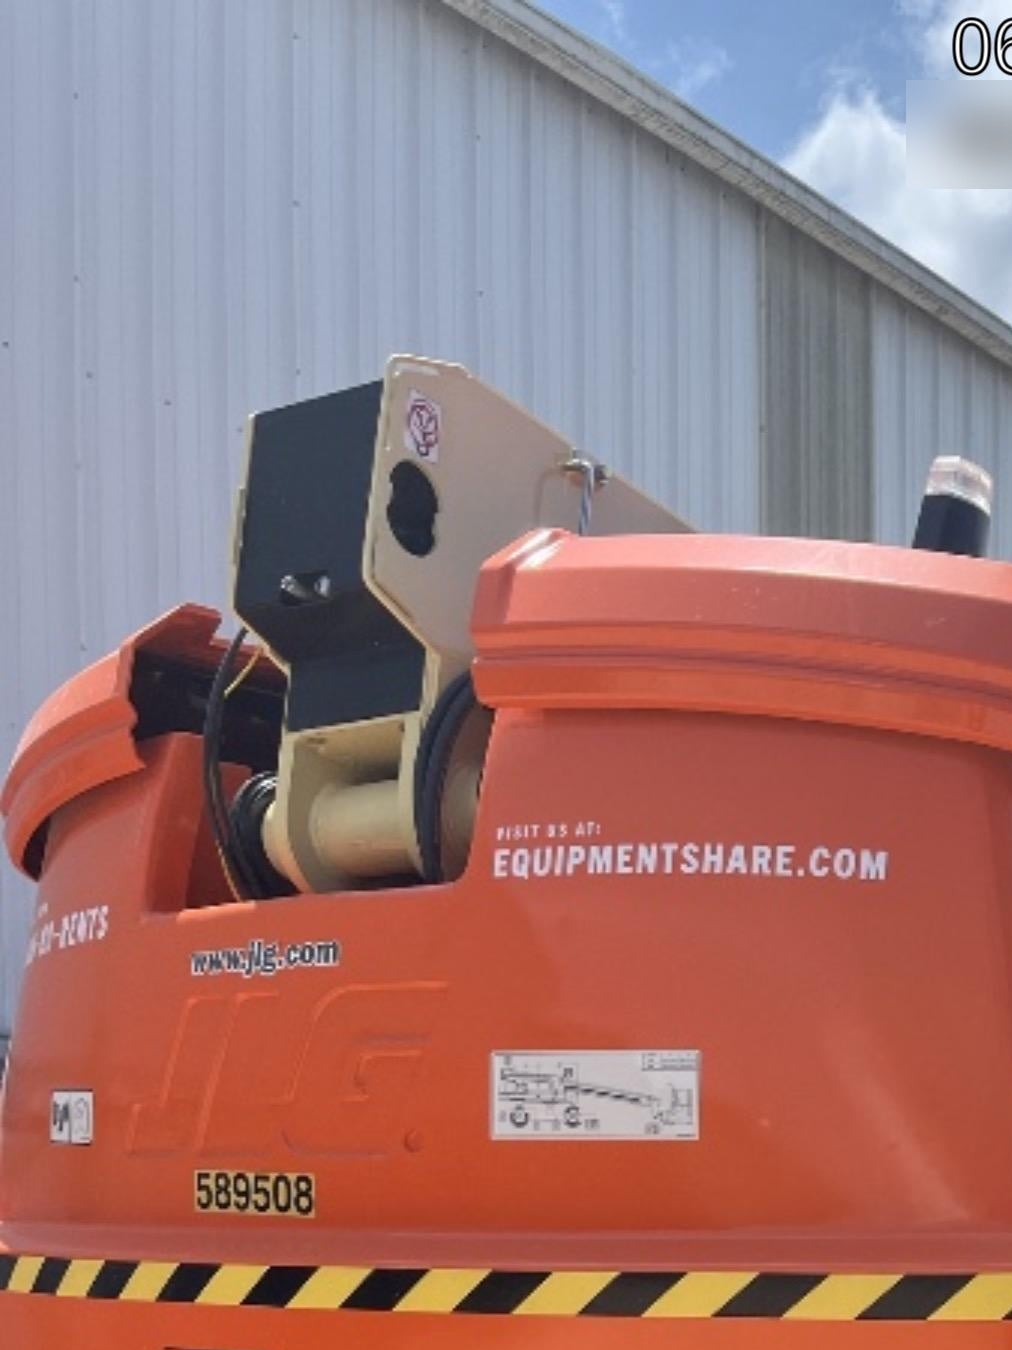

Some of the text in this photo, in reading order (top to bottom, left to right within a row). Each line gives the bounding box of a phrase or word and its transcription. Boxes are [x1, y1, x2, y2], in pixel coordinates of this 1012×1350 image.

[493, 844, 888, 880] EQUIPMENTSHARE.COM
[191, 939, 340, 978] www.jlg.com
[197, 1172, 313, 1215] 589508
